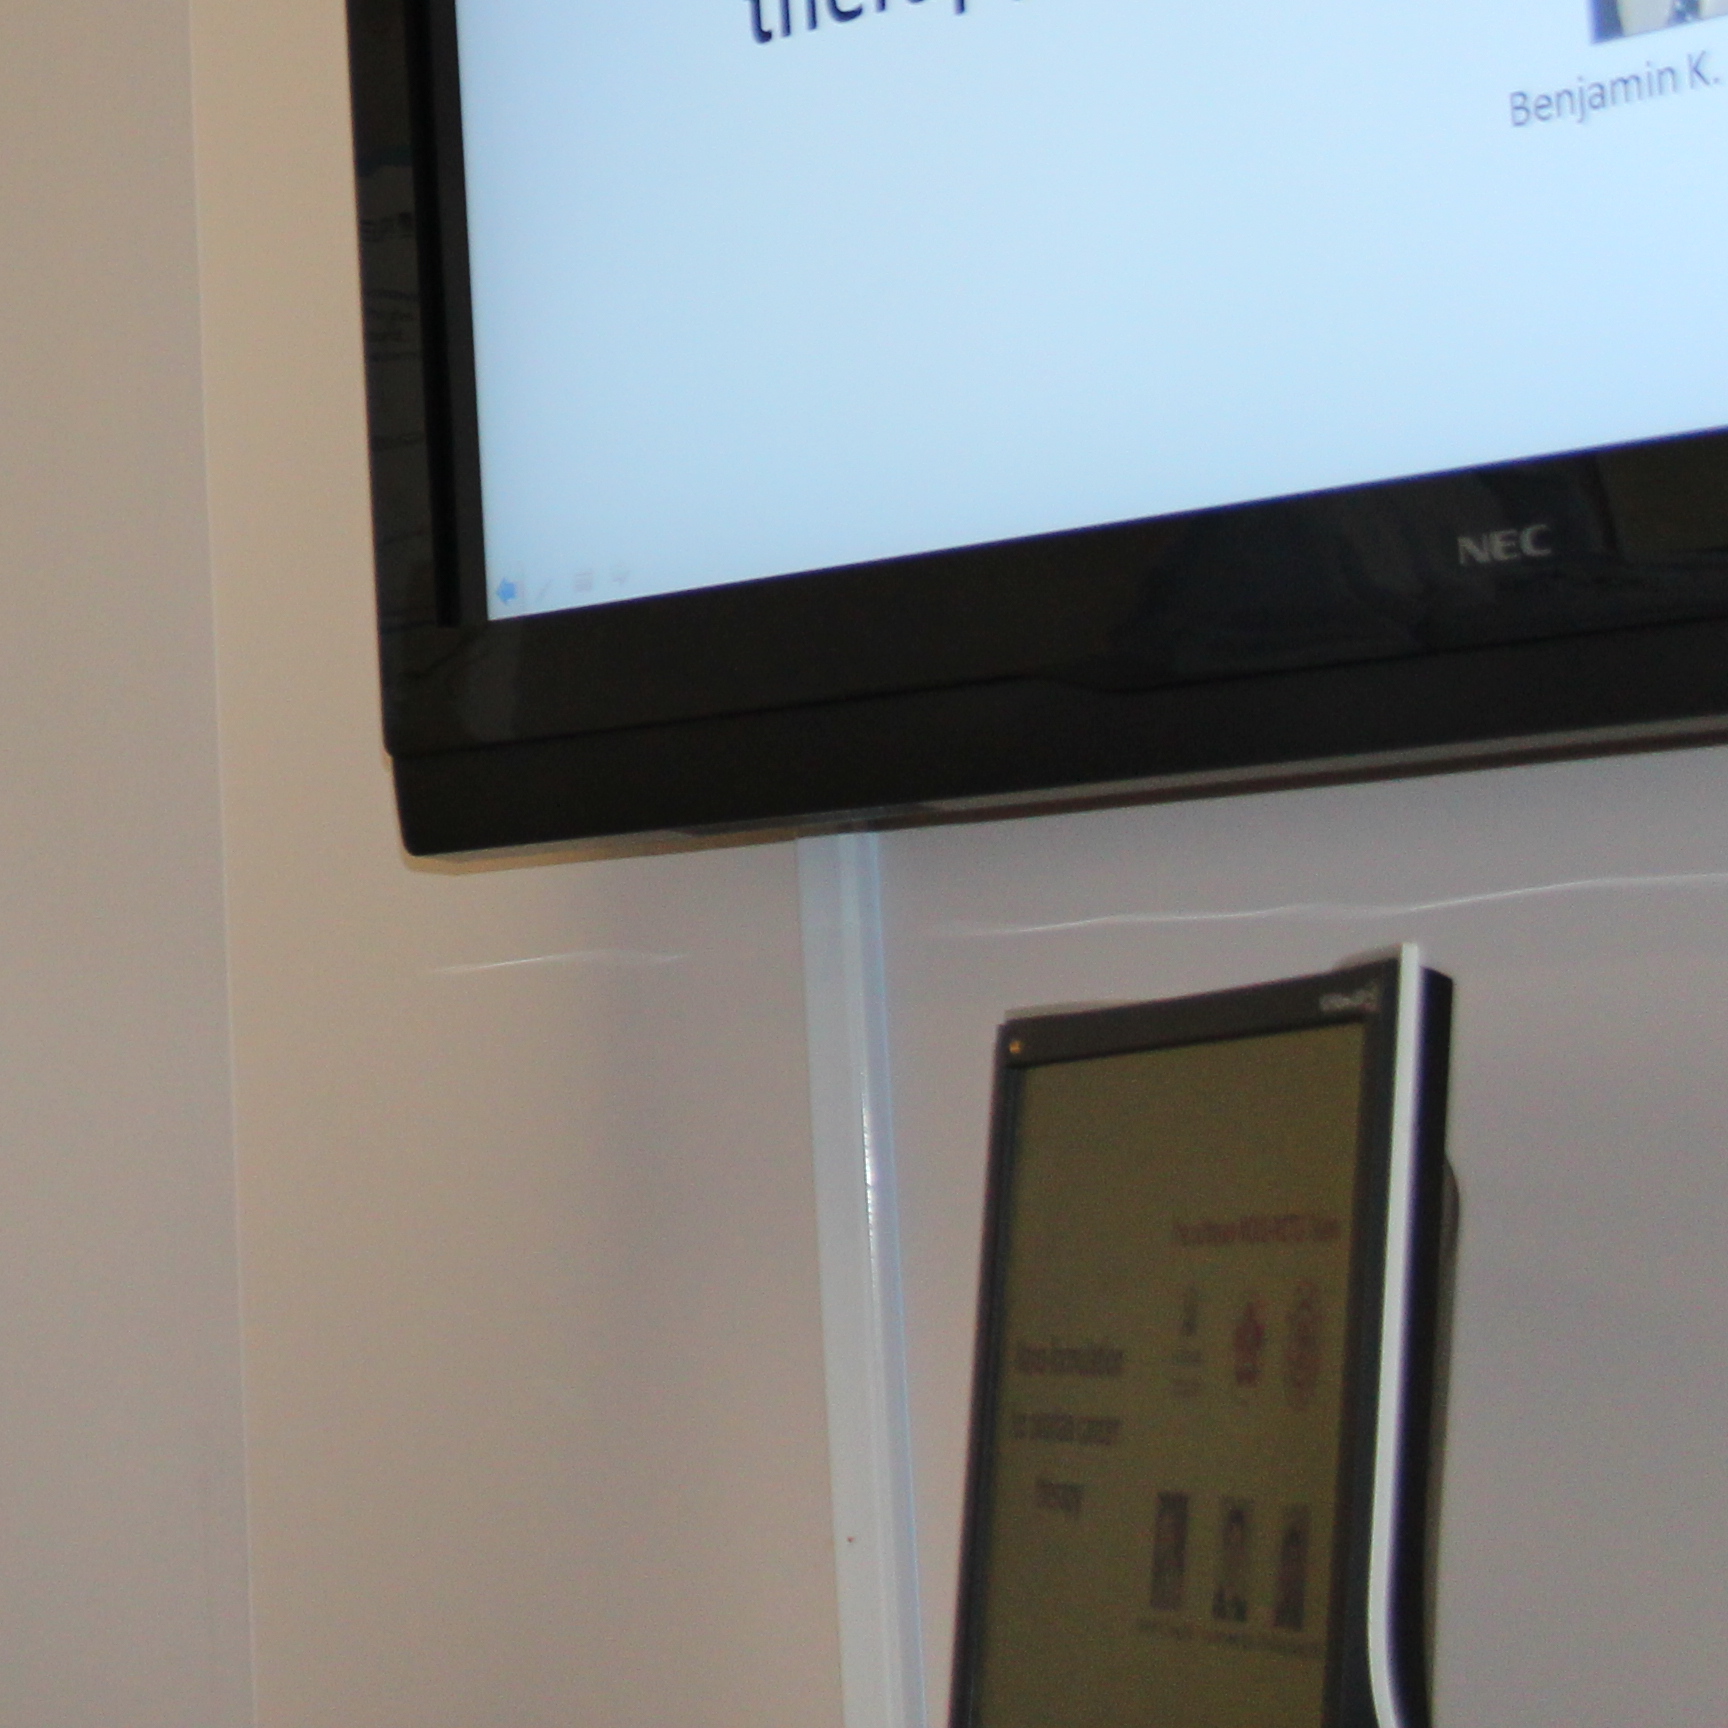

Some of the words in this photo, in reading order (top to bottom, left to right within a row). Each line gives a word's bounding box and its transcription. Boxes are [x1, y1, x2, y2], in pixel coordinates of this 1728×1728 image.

[1508, 60, 1679, 127] Benjamin
[1687, 49, 1720, 90] K.
[1457, 523, 1552, 565] NEC
